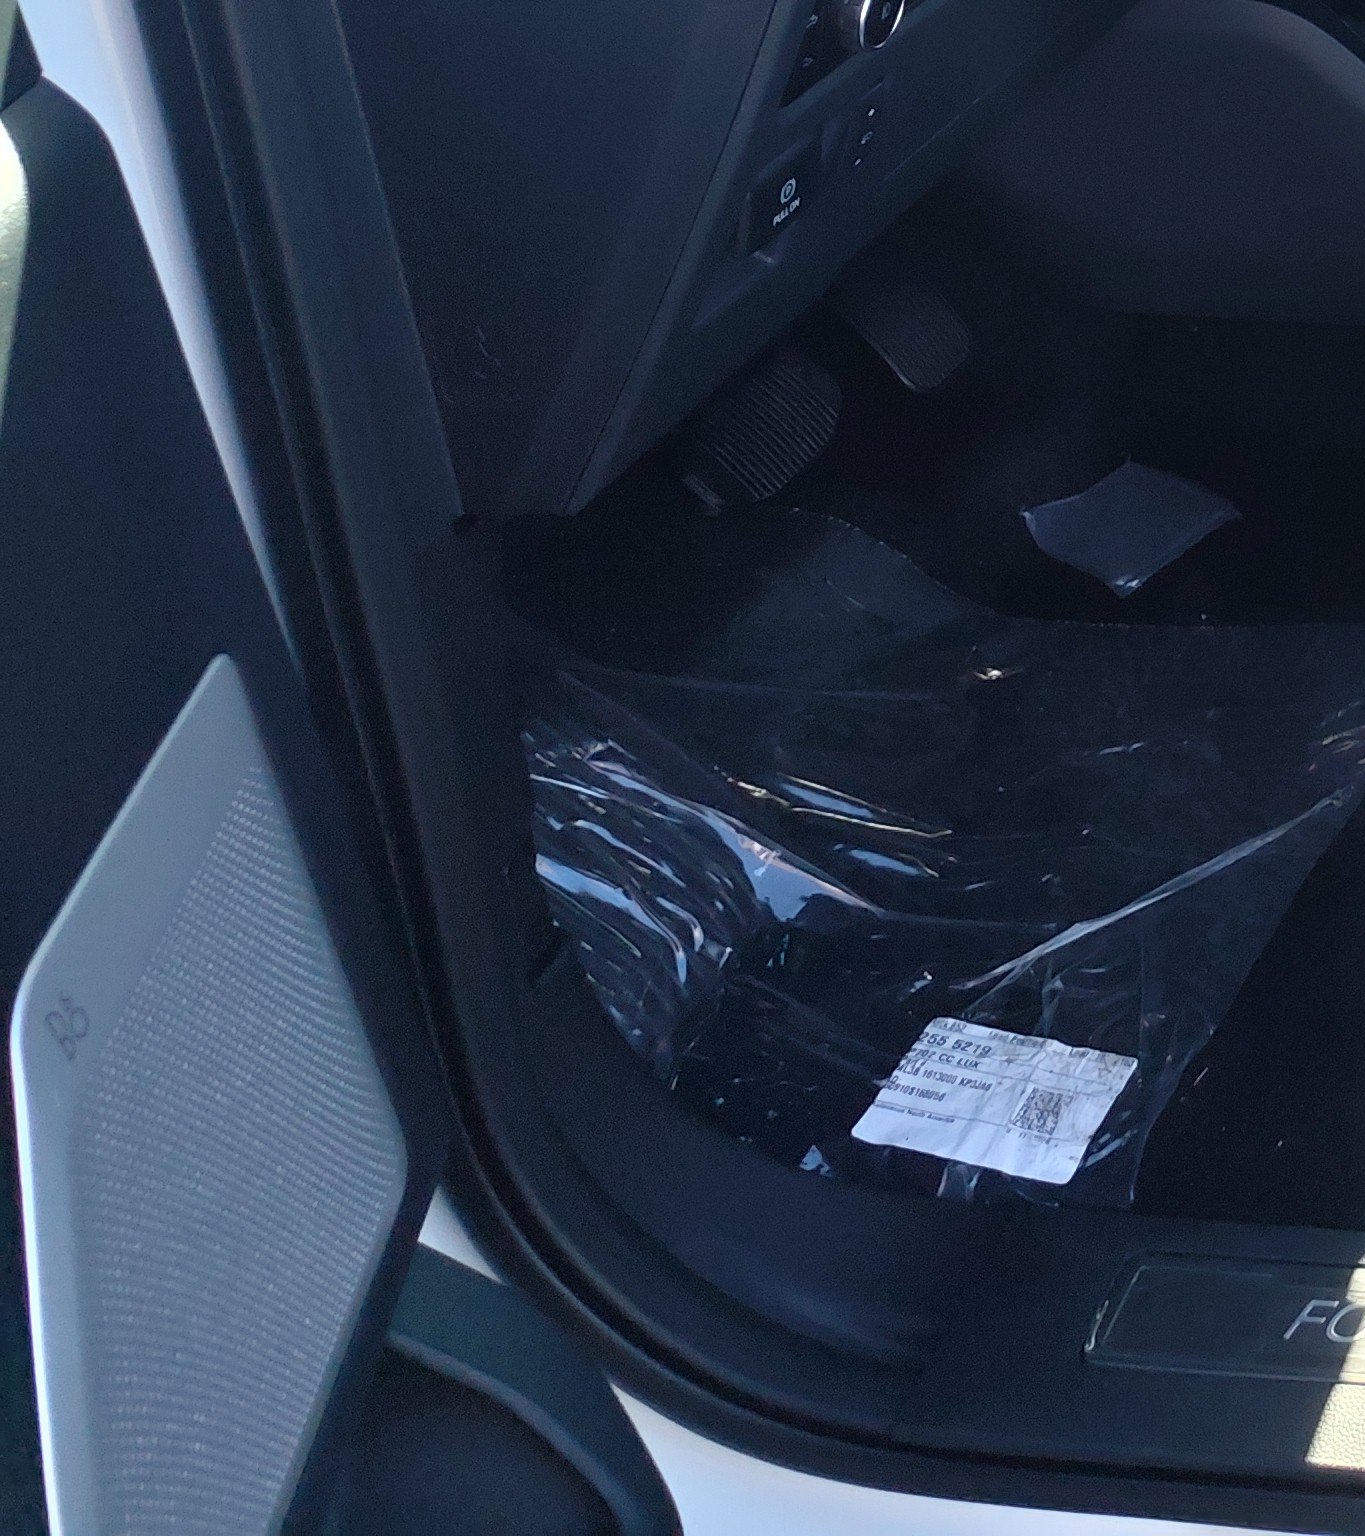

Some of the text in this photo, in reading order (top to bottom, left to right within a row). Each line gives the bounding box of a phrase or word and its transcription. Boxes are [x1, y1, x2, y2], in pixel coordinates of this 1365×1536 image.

[916, 1031, 994, 1057] 255 5219
[936, 1053, 956, 1063] CC
[955, 1057, 981, 1068] LUX
